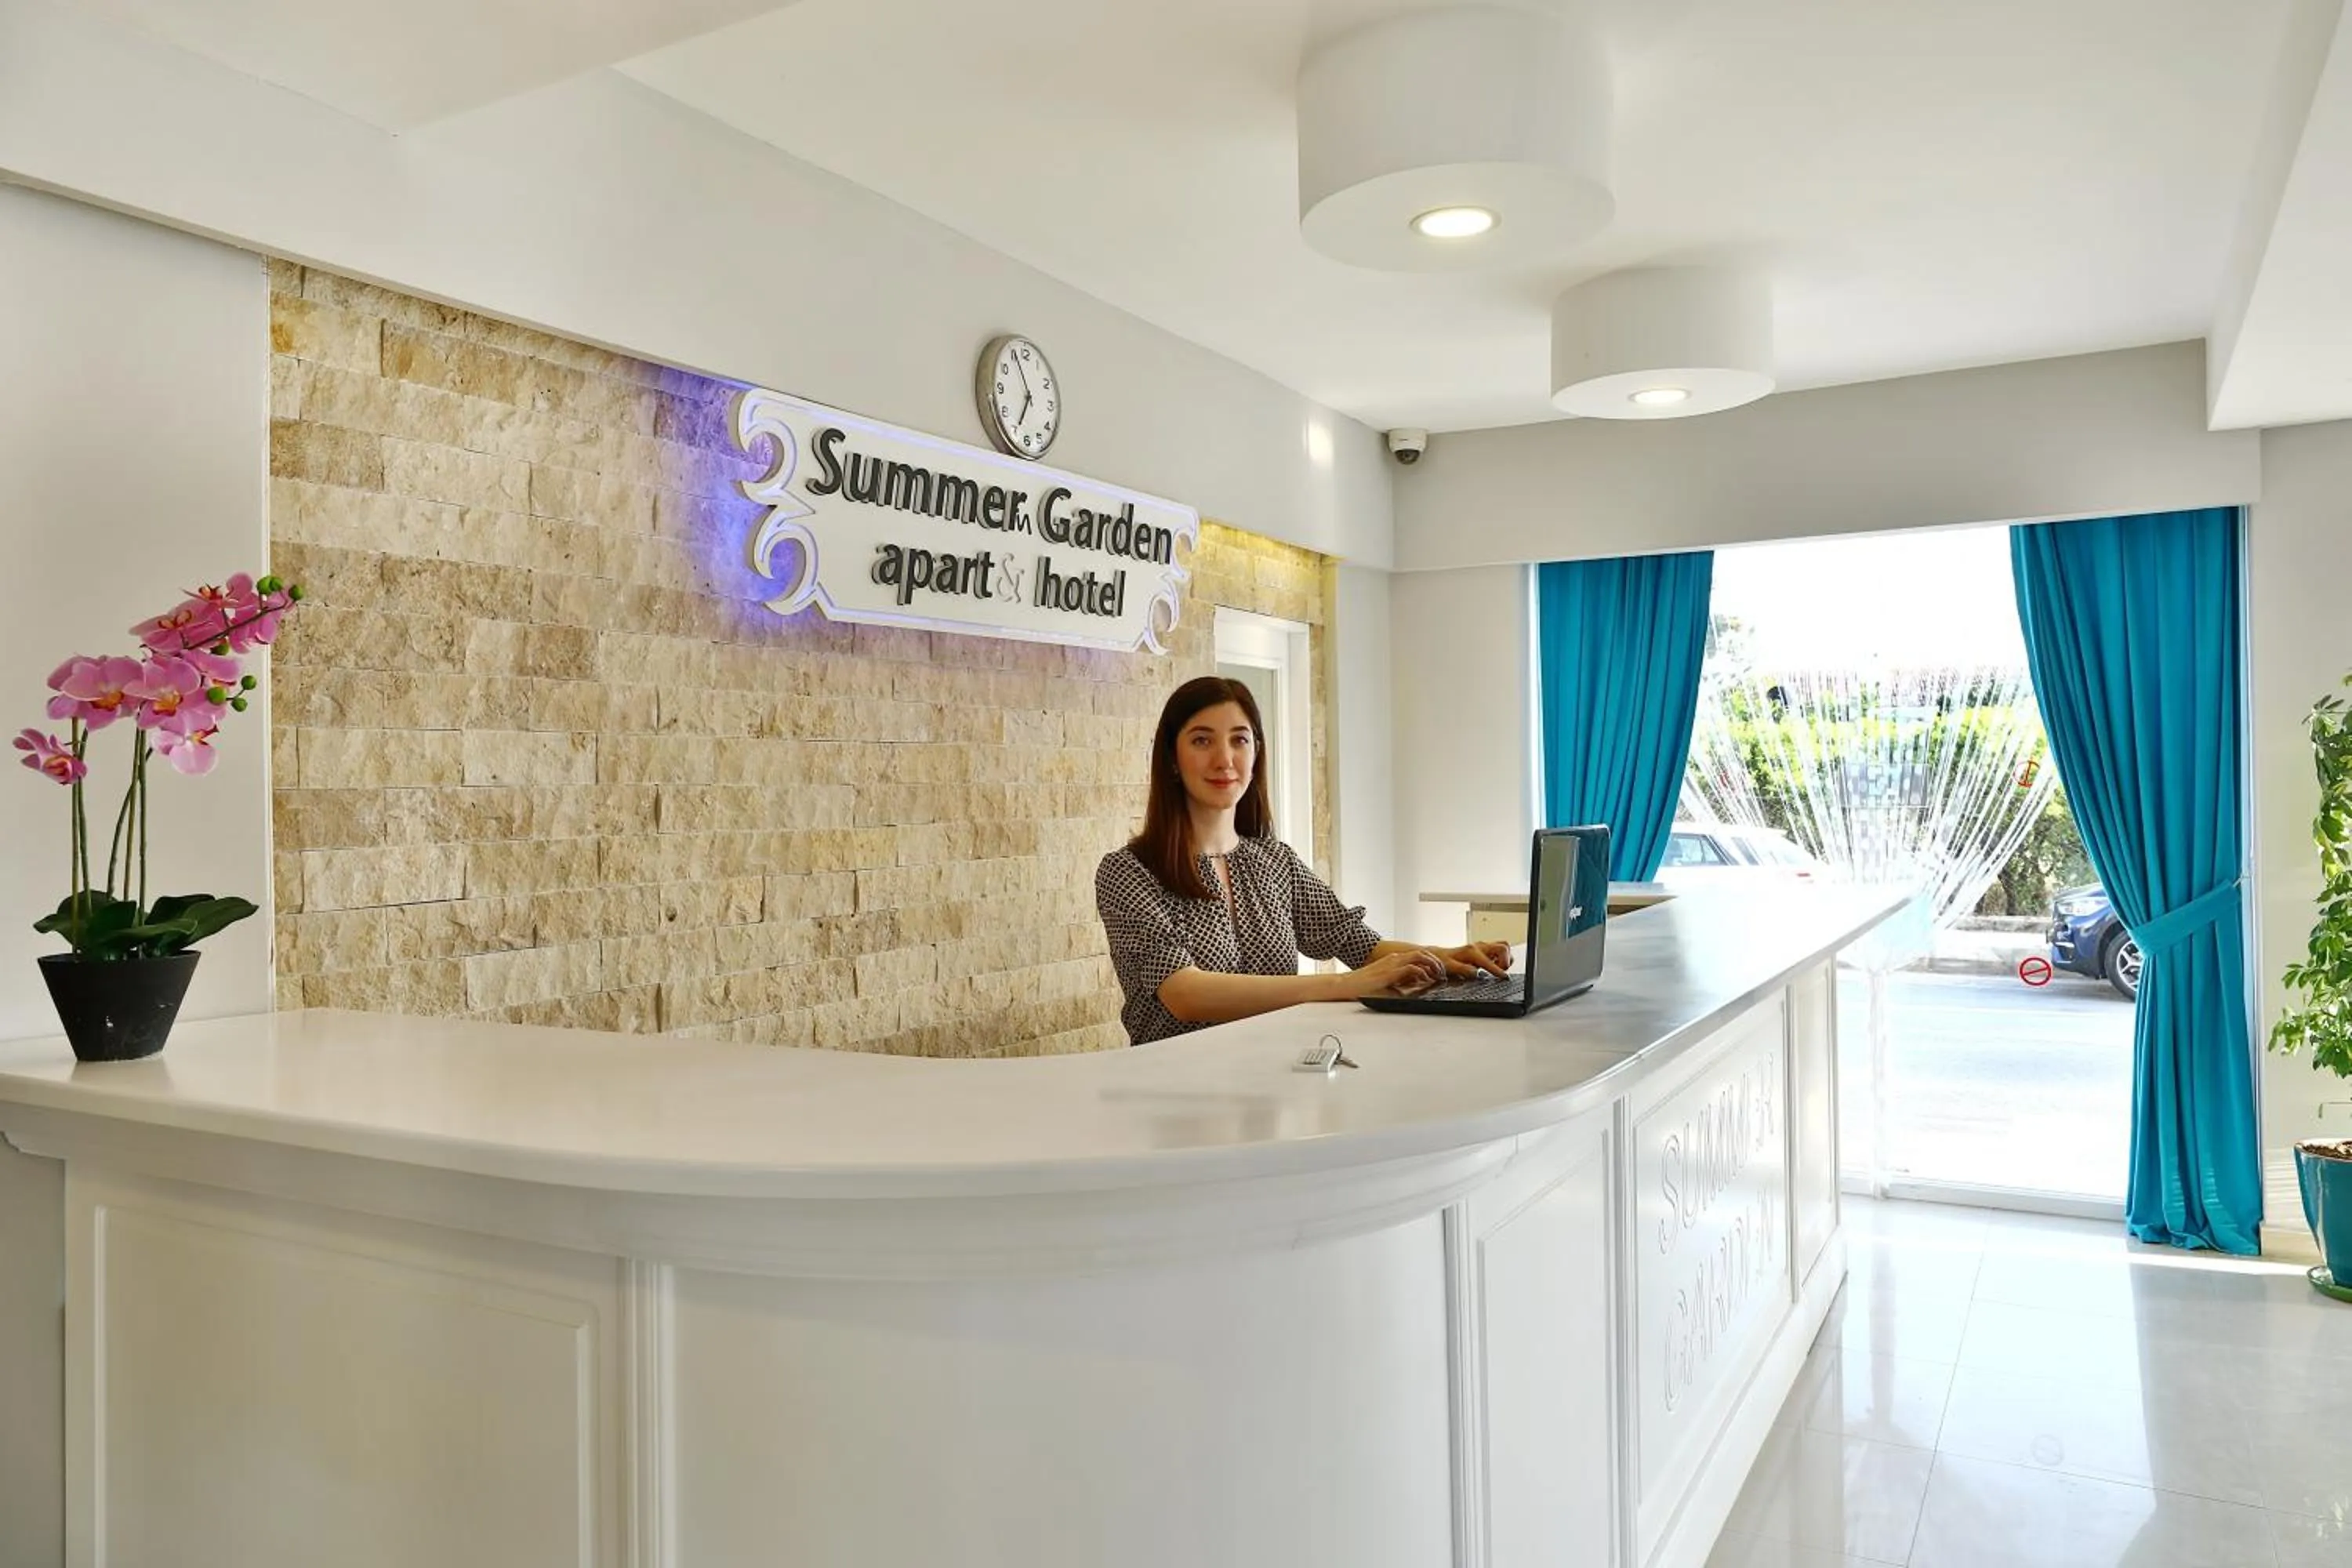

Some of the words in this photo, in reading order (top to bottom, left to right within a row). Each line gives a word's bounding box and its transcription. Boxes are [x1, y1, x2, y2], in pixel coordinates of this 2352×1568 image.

[1021, 348, 1030, 361] 12
[996, 382, 1004, 394] 9
[1043, 377, 1050, 389] 2
[1001, 405, 1009, 418] 8
[1047, 399, 1054, 412] 3
[1011, 424, 1018, 433] 7
[1044, 421, 1051, 431] 4
[1023, 434, 1031, 447] 6
[1036, 432, 1044, 445] 5
[806, 428, 1028, 531] Summer
[1037, 486, 1172, 564] Garden
[871, 543, 995, 605] apart
[996, 552, 1025, 604] &
[1033, 556, 1126, 617] hotel
